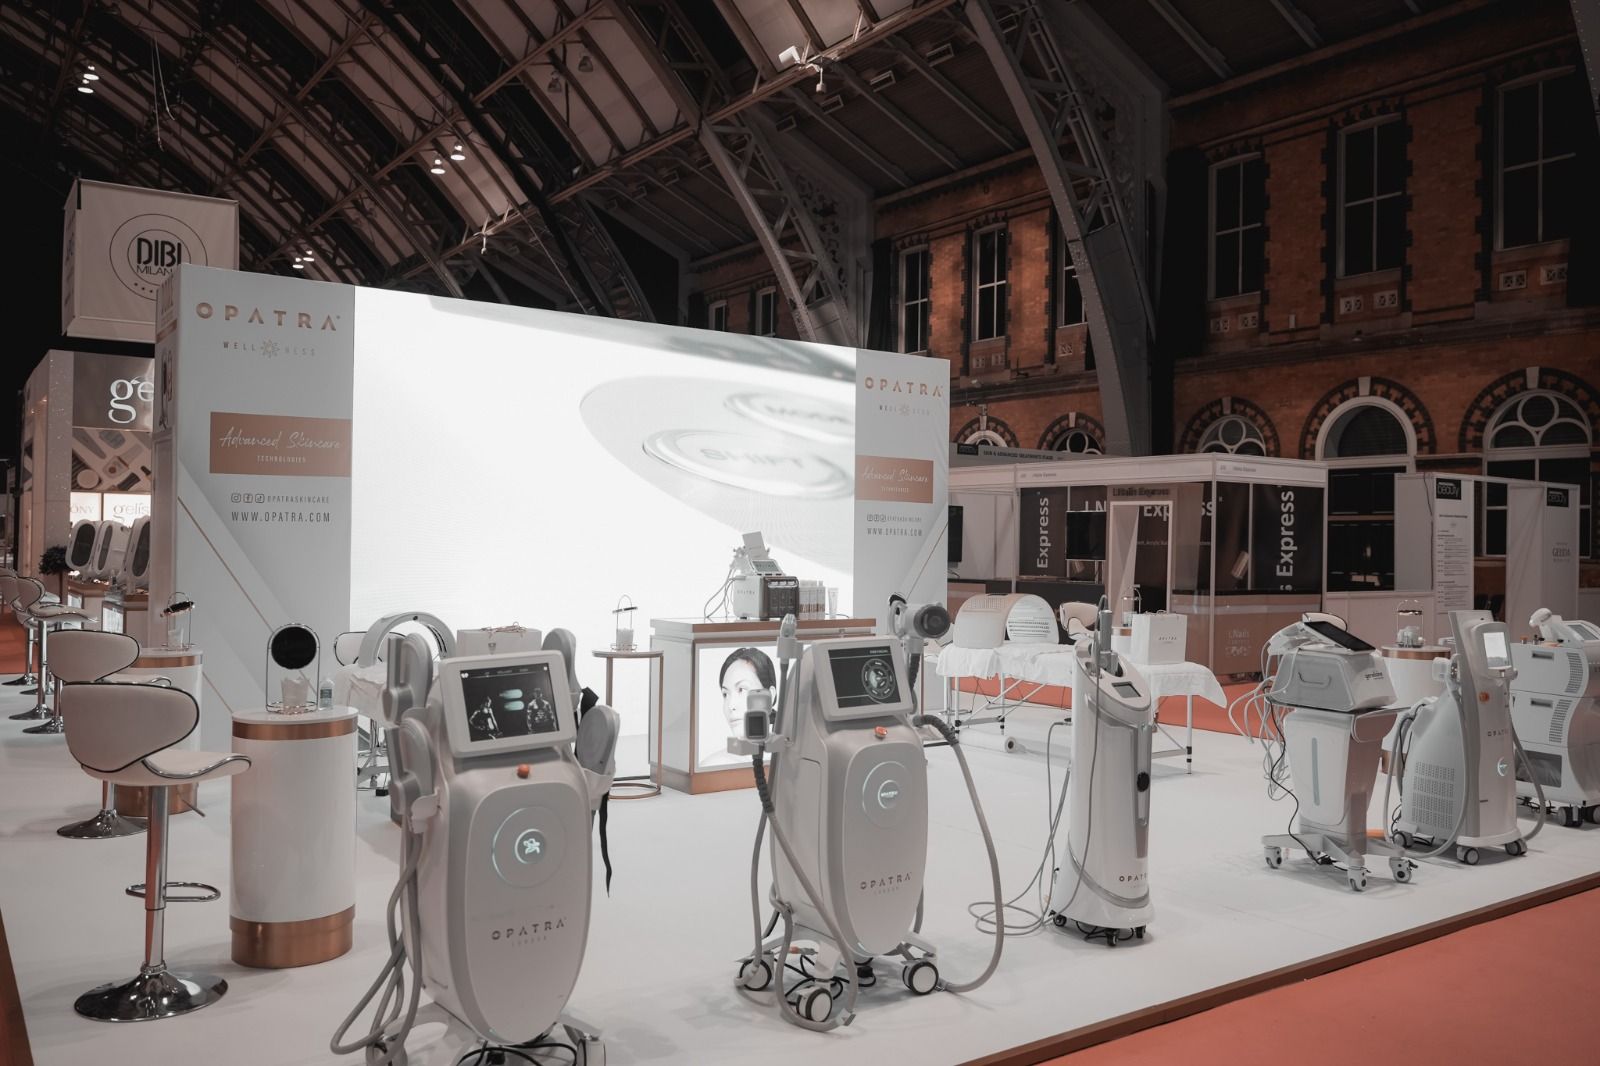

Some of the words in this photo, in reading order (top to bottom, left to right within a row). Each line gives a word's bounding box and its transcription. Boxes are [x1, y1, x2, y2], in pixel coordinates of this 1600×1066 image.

[136, 237, 182, 267] DIBI
[136, 265, 174, 276] MILAN
[196, 302, 337, 331] OPATRA
[864, 376, 942, 398] OPATRA
[108, 377, 154, 423] ge
[219, 426, 283, 450] Advanced
[231, 511, 331, 523] WWW.OPATRA.COM
[1036, 497, 1050, 569] Express
[1275, 491, 1298, 577] Express
[860, 873, 912, 890] OPATRA
[491, 918, 566, 941] OPATRA
